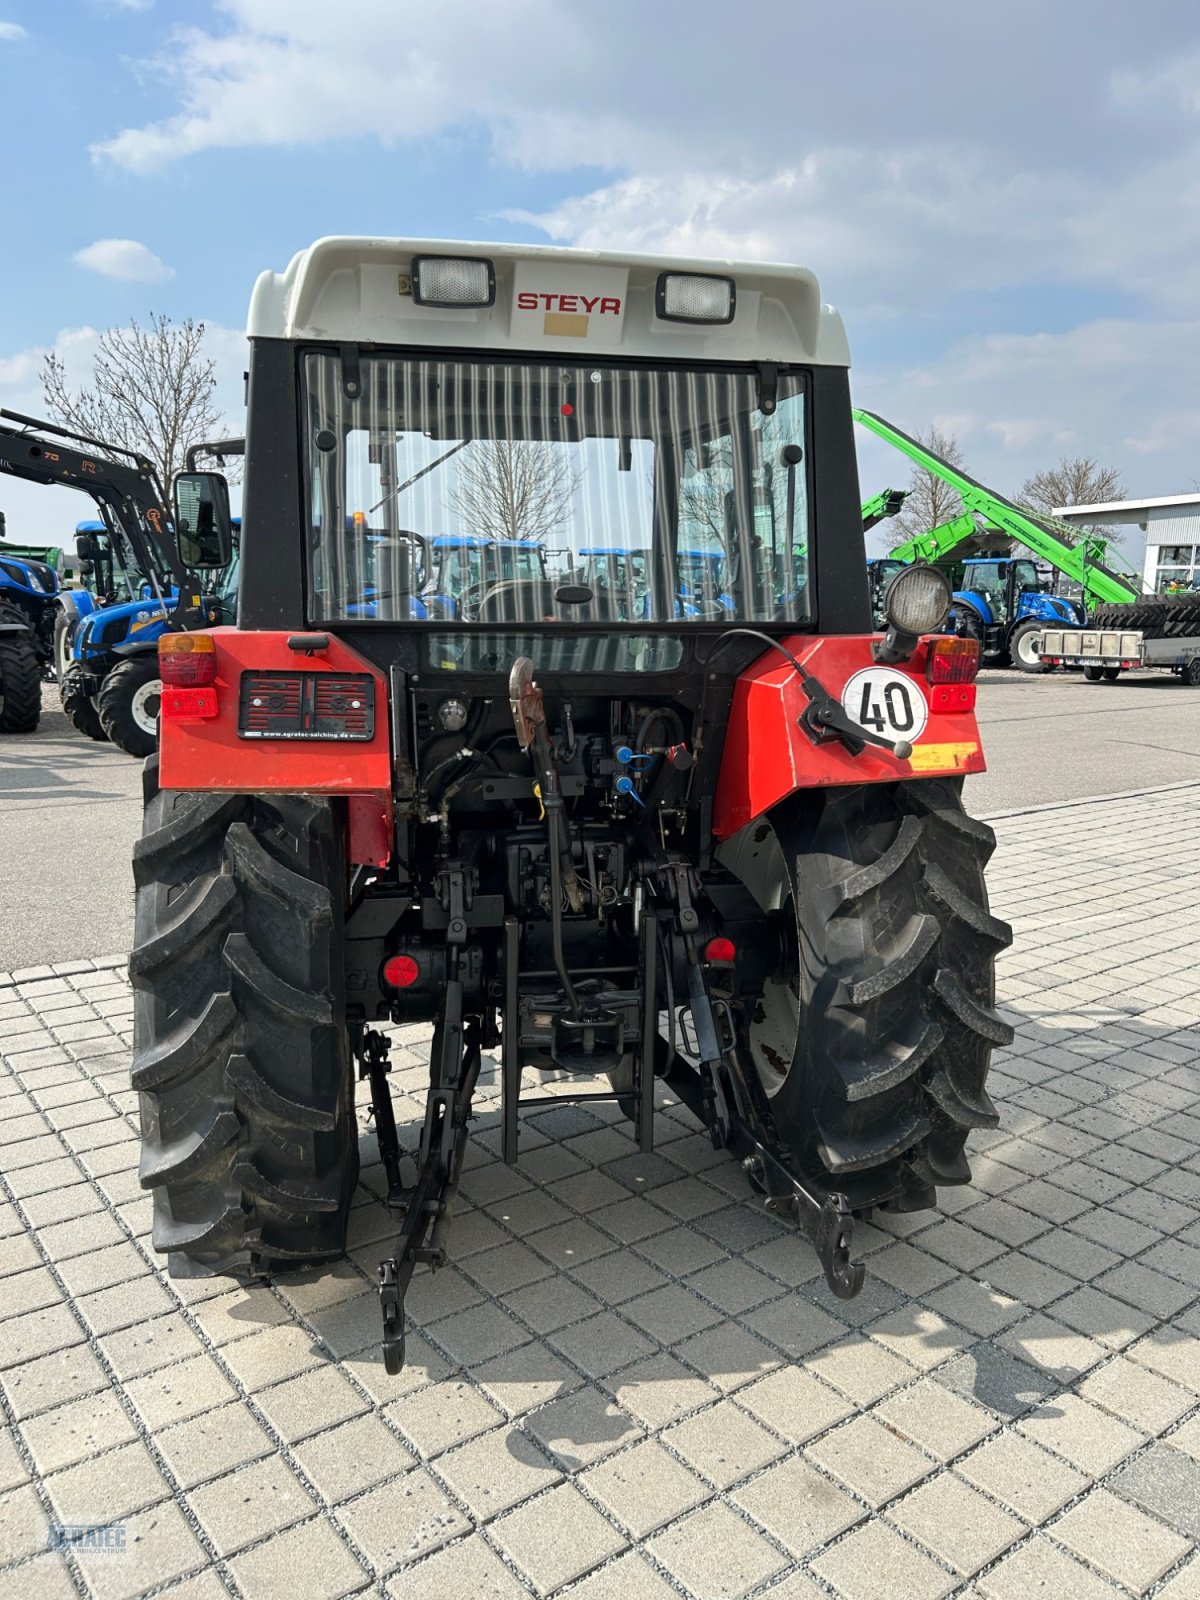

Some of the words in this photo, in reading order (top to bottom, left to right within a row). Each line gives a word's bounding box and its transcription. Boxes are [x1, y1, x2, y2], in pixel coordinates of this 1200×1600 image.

[518, 292, 621, 315] STEYR
[860, 681, 914, 732] 40
[263, 731, 348, 739] www.agratec-salching.de
